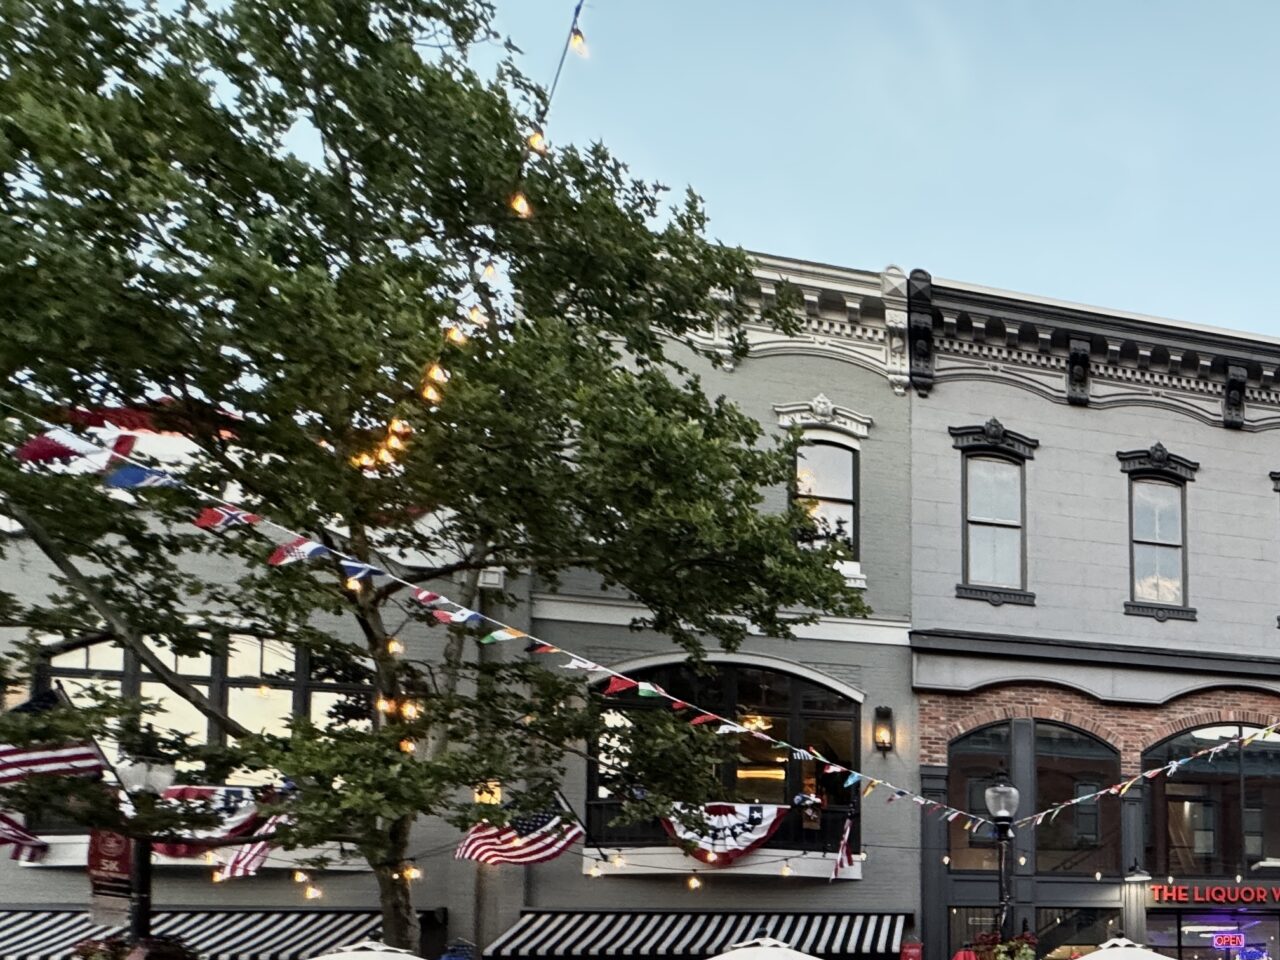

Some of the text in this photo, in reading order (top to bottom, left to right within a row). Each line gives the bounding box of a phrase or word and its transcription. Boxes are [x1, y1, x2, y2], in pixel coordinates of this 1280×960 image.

[1151, 885, 1189, 902] THE
[1194, 886, 1268, 904] LIQUOR
[1216, 936, 1243, 946] OPEN
